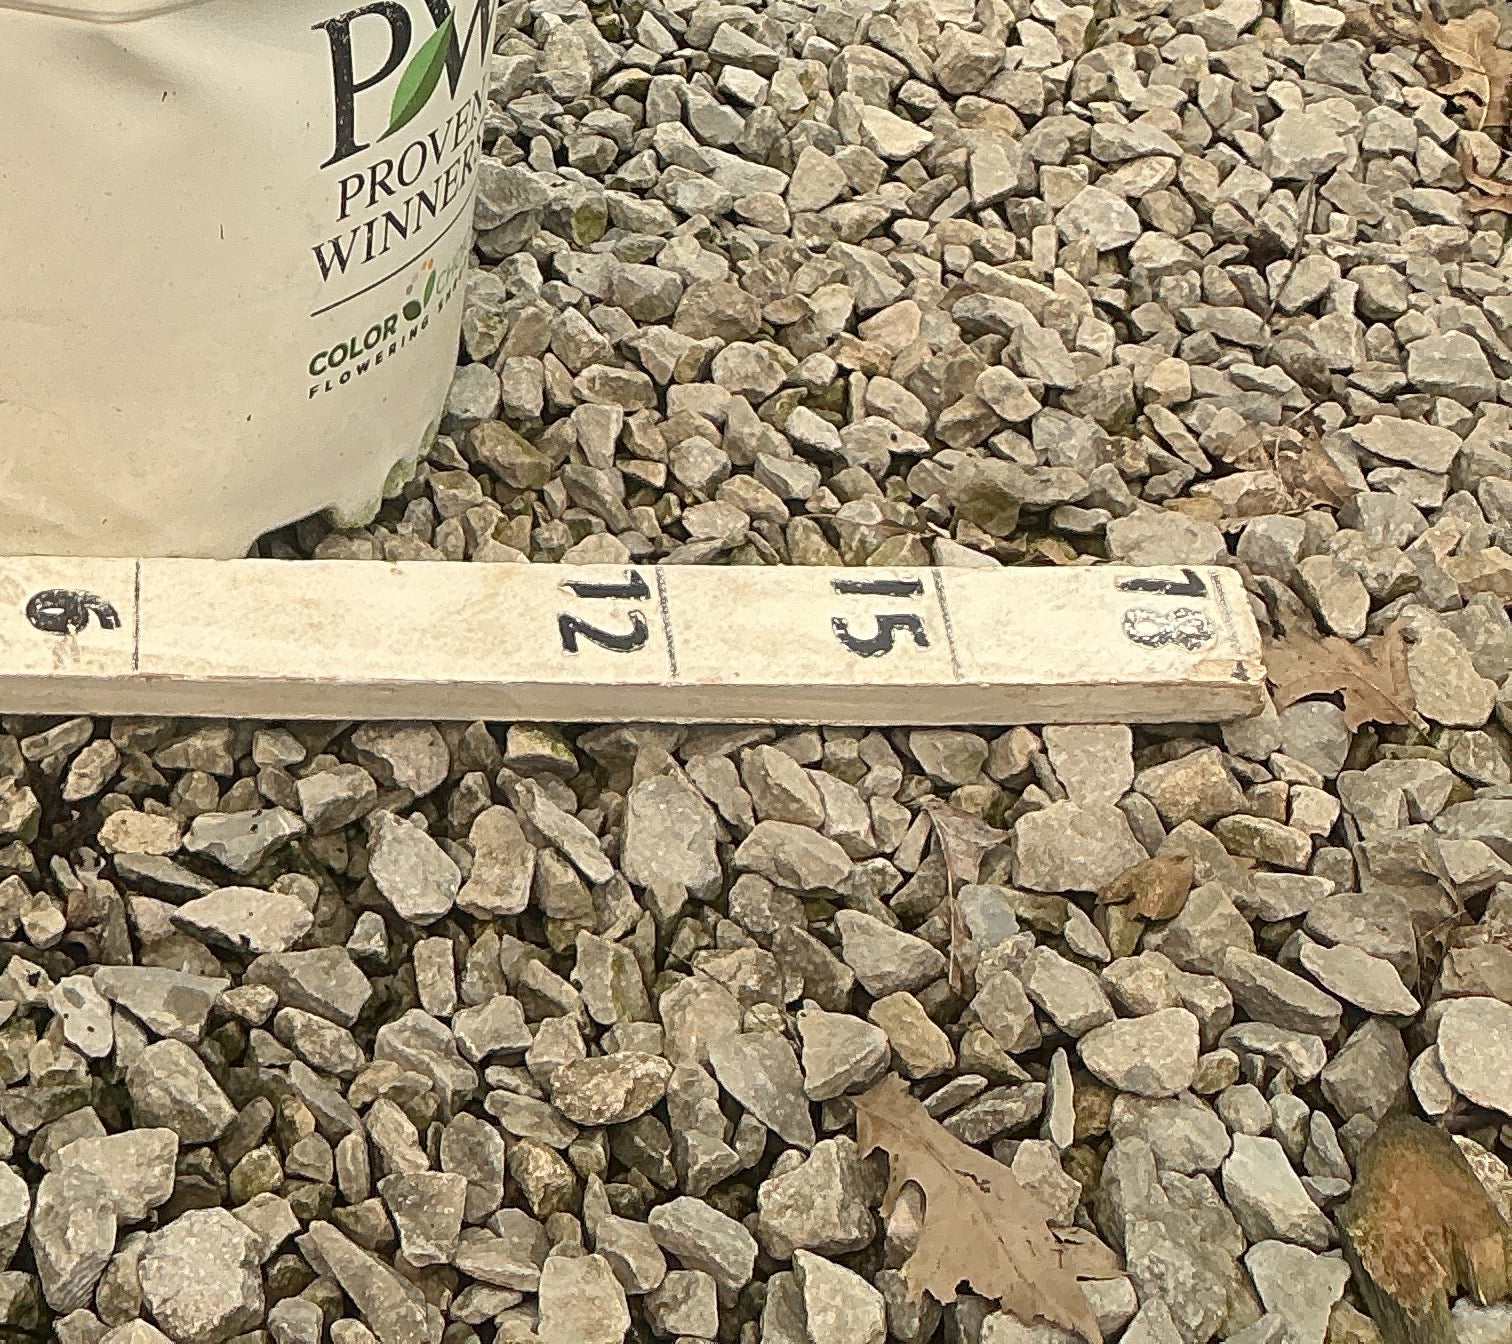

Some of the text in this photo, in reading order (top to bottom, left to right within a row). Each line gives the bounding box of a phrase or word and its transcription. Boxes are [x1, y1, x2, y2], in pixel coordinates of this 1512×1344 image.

[311, 135, 479, 283] WINNER
[308, 312, 399, 377] COLOR
[308, 314, 430, 400] FLOWERING
[557, 568, 651, 655] 12
[830, 576, 930, 659] 15
[1114, 567, 1217, 652] 18
